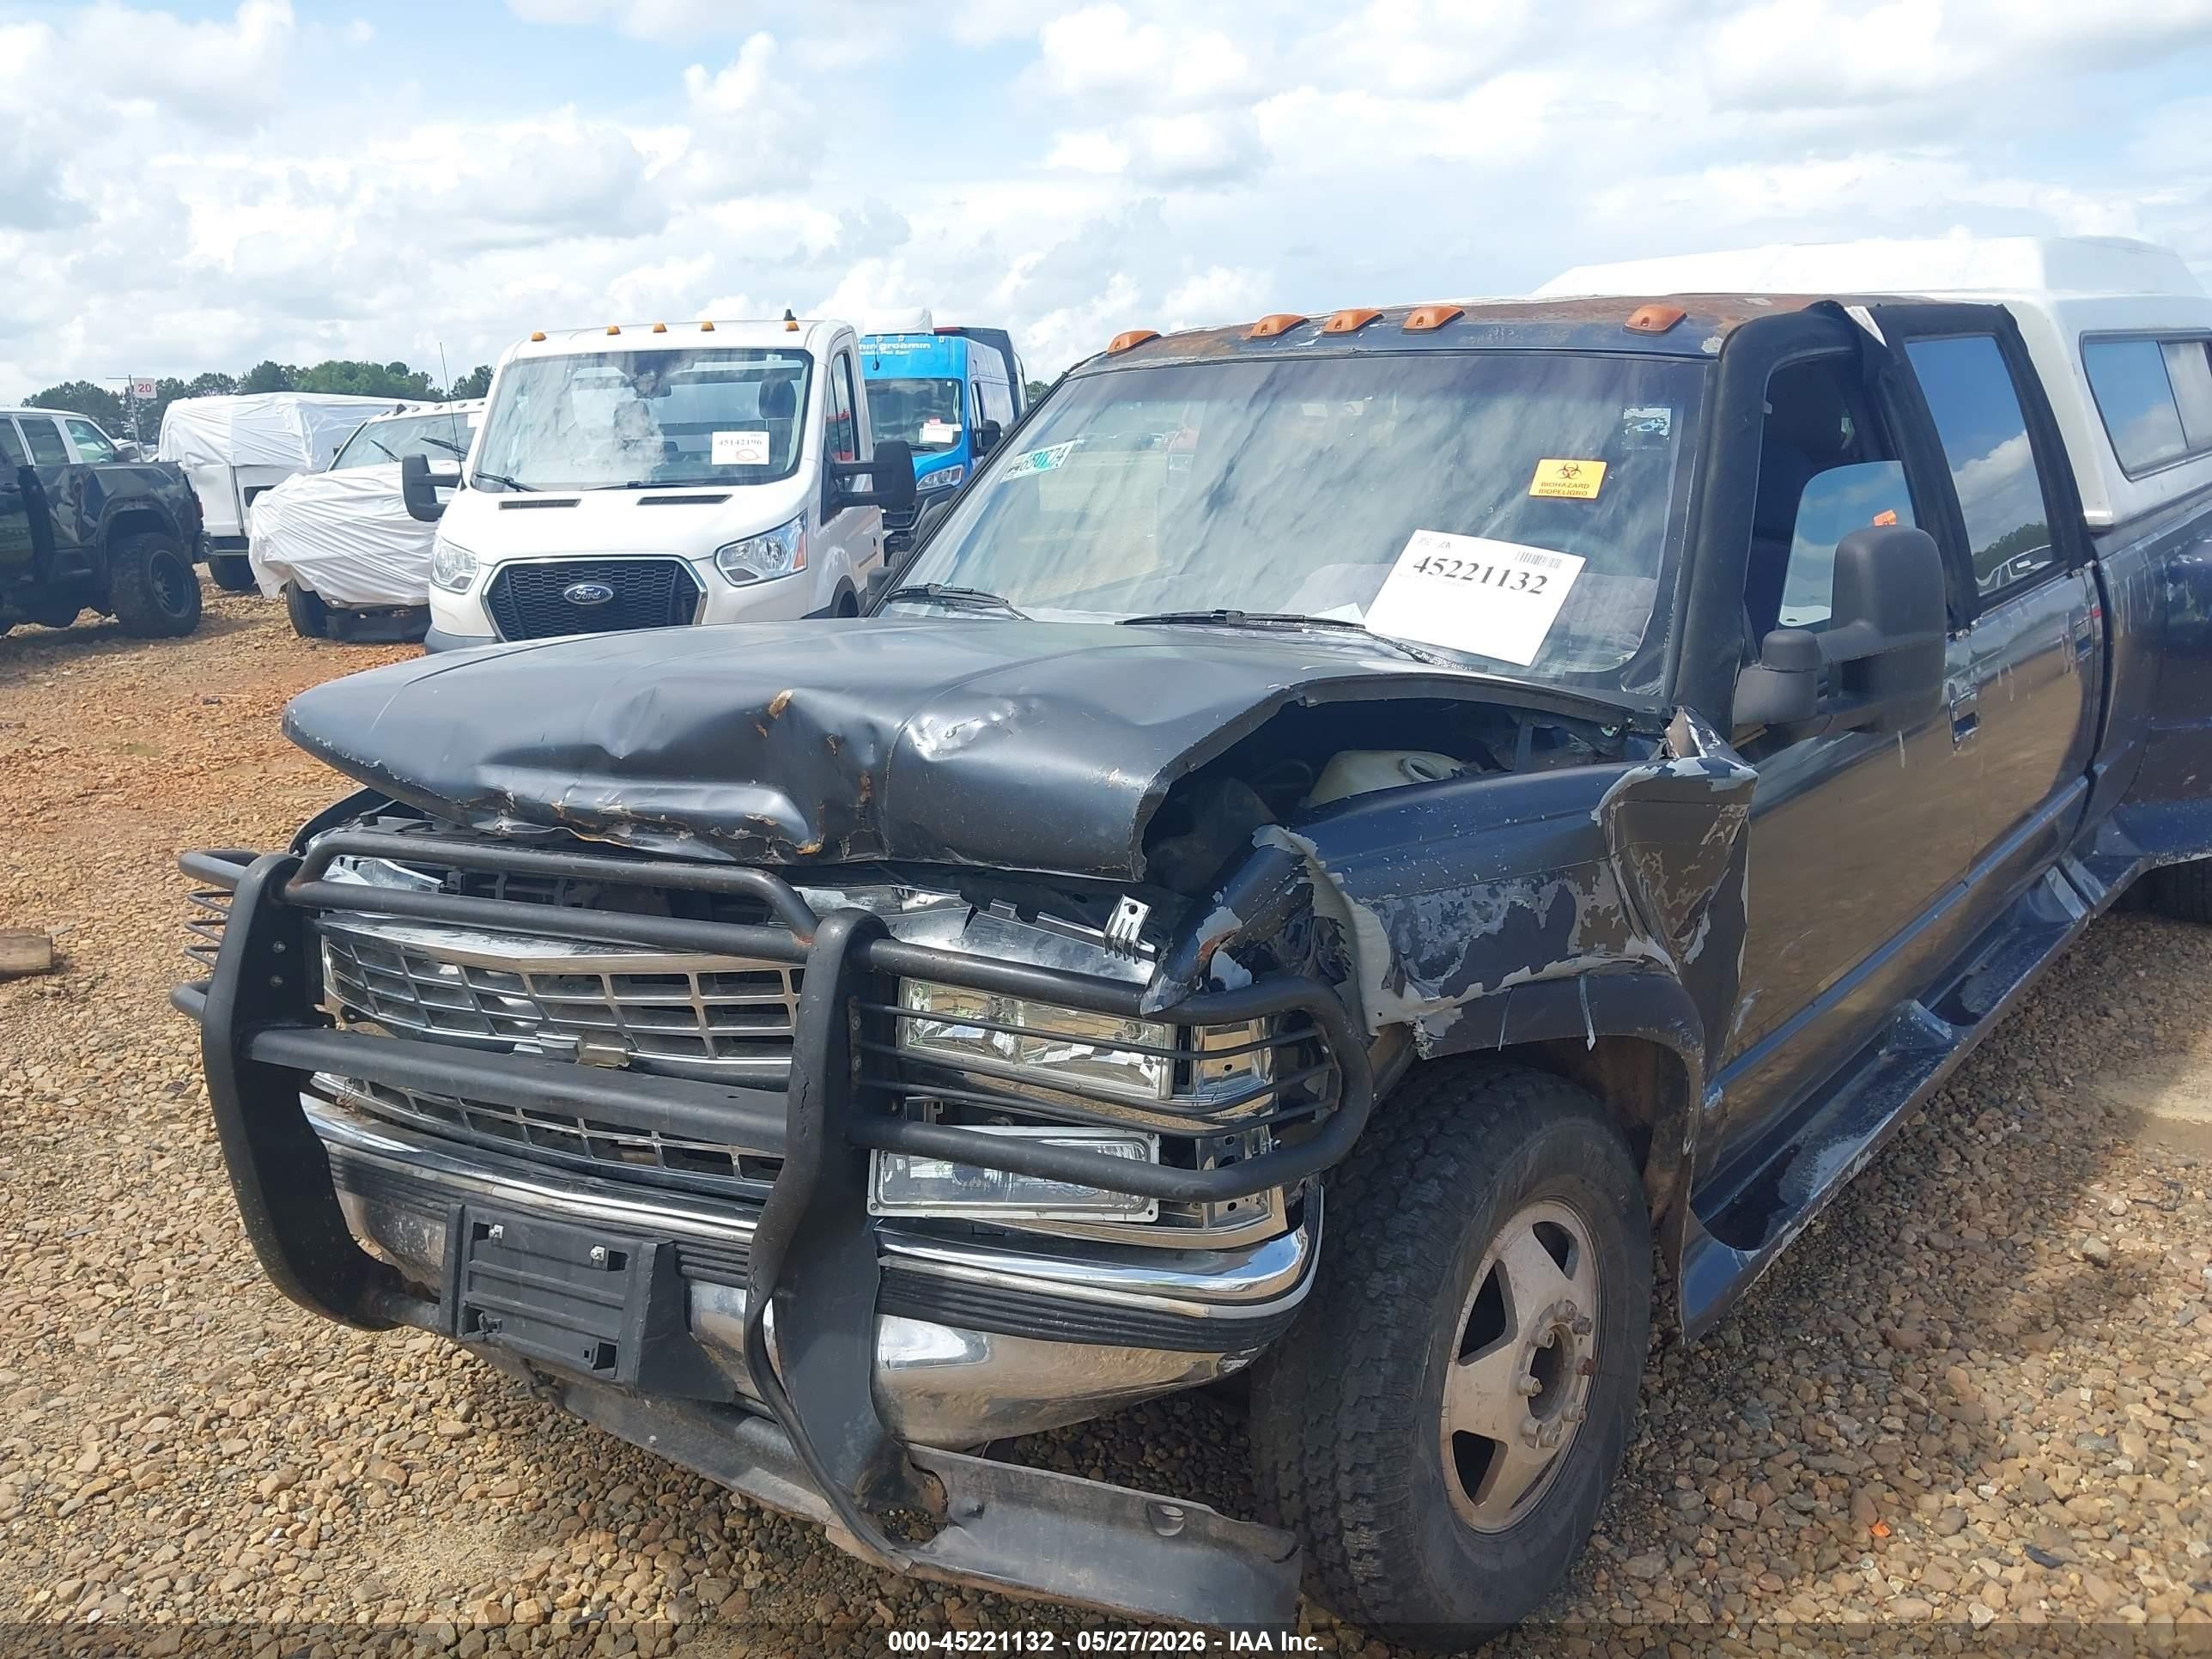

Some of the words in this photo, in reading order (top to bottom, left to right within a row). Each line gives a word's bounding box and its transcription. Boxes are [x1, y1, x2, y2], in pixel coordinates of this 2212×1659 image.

[137, 383, 152, 392] 20
[1540, 481, 1590, 489] BIOHAZARD
[1538, 488, 1589, 496] BIOPELIGRO
[1413, 556, 1548, 595] 45221132
[574, 587, 602, 599] Ford
